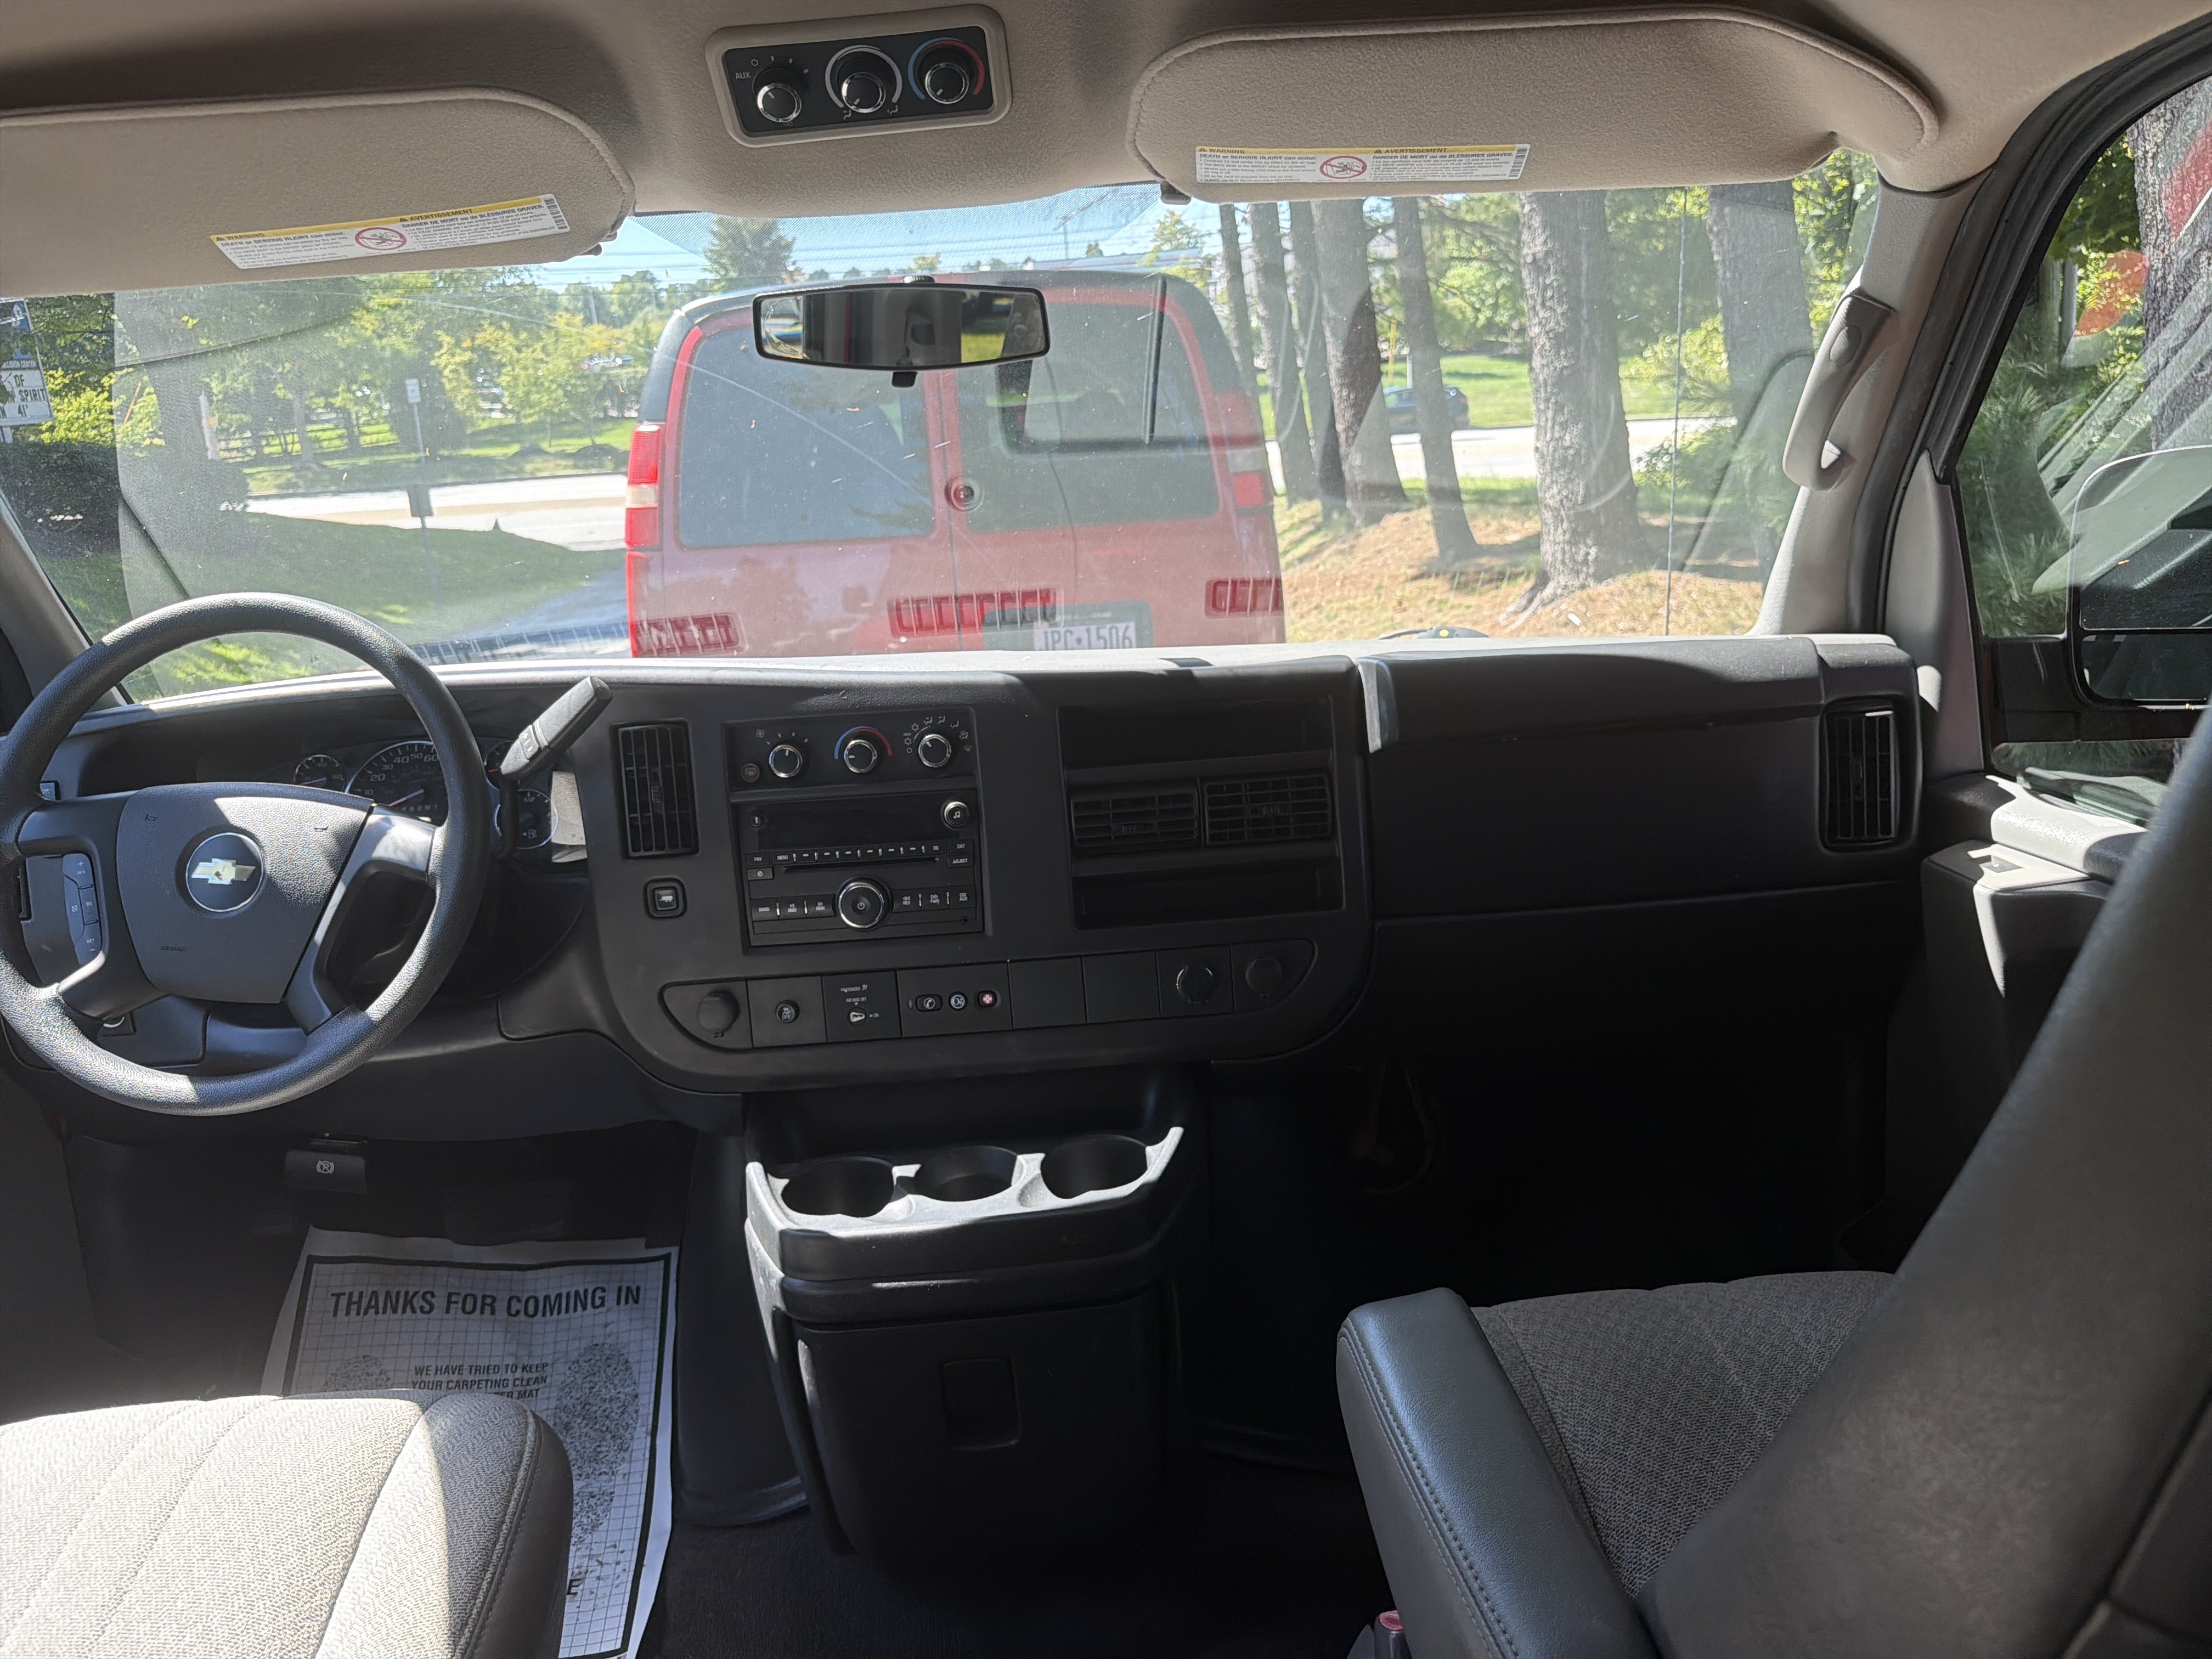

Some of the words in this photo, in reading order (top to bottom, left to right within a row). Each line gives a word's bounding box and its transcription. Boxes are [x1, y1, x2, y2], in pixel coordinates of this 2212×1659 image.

[736, 71, 751, 80] AUX
[410, 208, 473, 221] AVERTISSEMENT
[479, 210, 516, 218] BLESSURES
[517, 205, 545, 213] GRAVES.
[14, 374, 25, 387] OF
[19, 389, 46, 402] SPIRIT
[393, 755, 410, 764] 40
[330, 1289, 436, 1319] THANKS
[444, 1291, 496, 1316] FOR
[506, 1285, 607, 1318] COMING
[616, 1284, 642, 1307] IN
[414, 1365, 432, 1376] WE
[435, 1364, 464, 1376] HAVE
[468, 1364, 500, 1375] TRIED
[504, 1363, 518, 1374] TO
[522, 1362, 549, 1373] KEEP
[411, 1380, 442, 1391] YOUR
[446, 1378, 510, 1390] CARPETING
[512, 1375, 548, 1387] CLEAN
[517, 1388, 540, 1400] MAT
